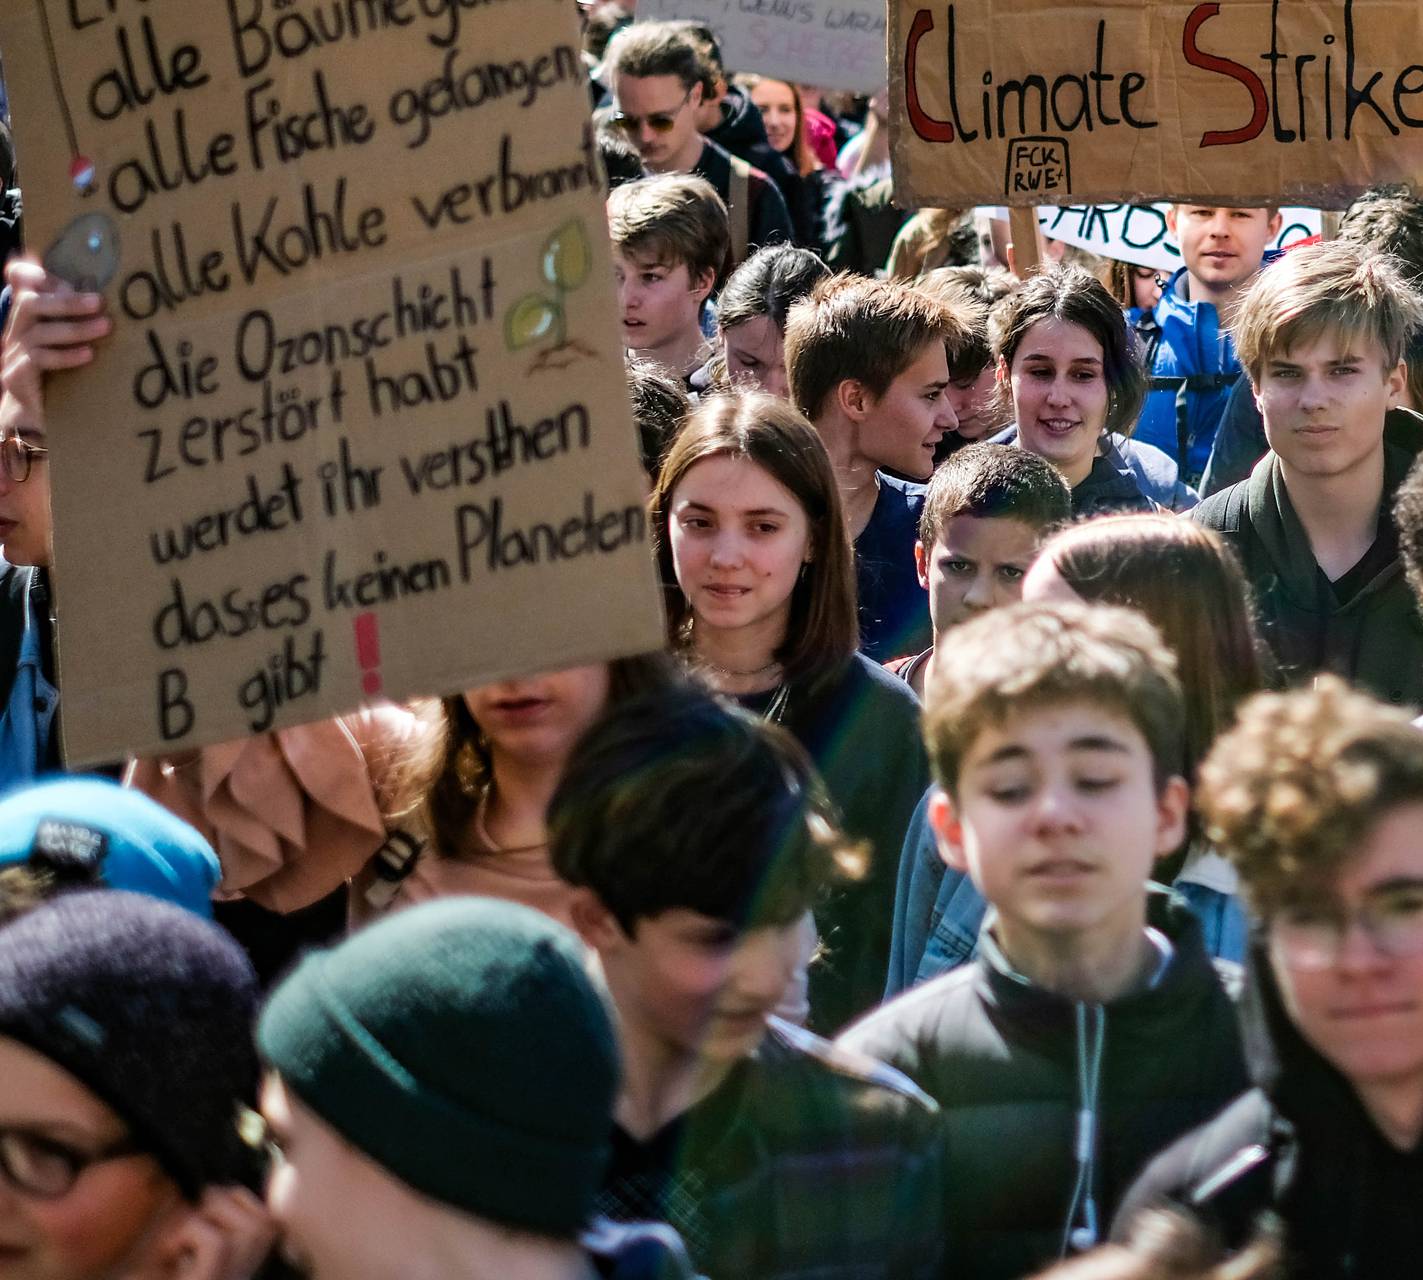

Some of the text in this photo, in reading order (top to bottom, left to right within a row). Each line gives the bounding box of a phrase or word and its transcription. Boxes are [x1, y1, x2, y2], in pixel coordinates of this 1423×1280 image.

[87, 14, 211, 121] alle
[904, 3, 1159, 143] Climate
[107, 106, 236, 213] alle
[245, 70, 376, 170] Fische
[1015, 146, 1061, 168] FCK
[118, 124, 603, 320] alle Kohle verbrannt
[133, 255, 498, 410] die Ozonschicht
[136, 334, 480, 484] zerstört habt
[150, 467, 303, 565] werdet
[318, 436, 384, 518] ihr
[323, 549, 452, 611] keinen
[454, 490, 647, 584] Planeten
[156, 667, 196, 741] B
[237, 629, 327, 733] gibt
